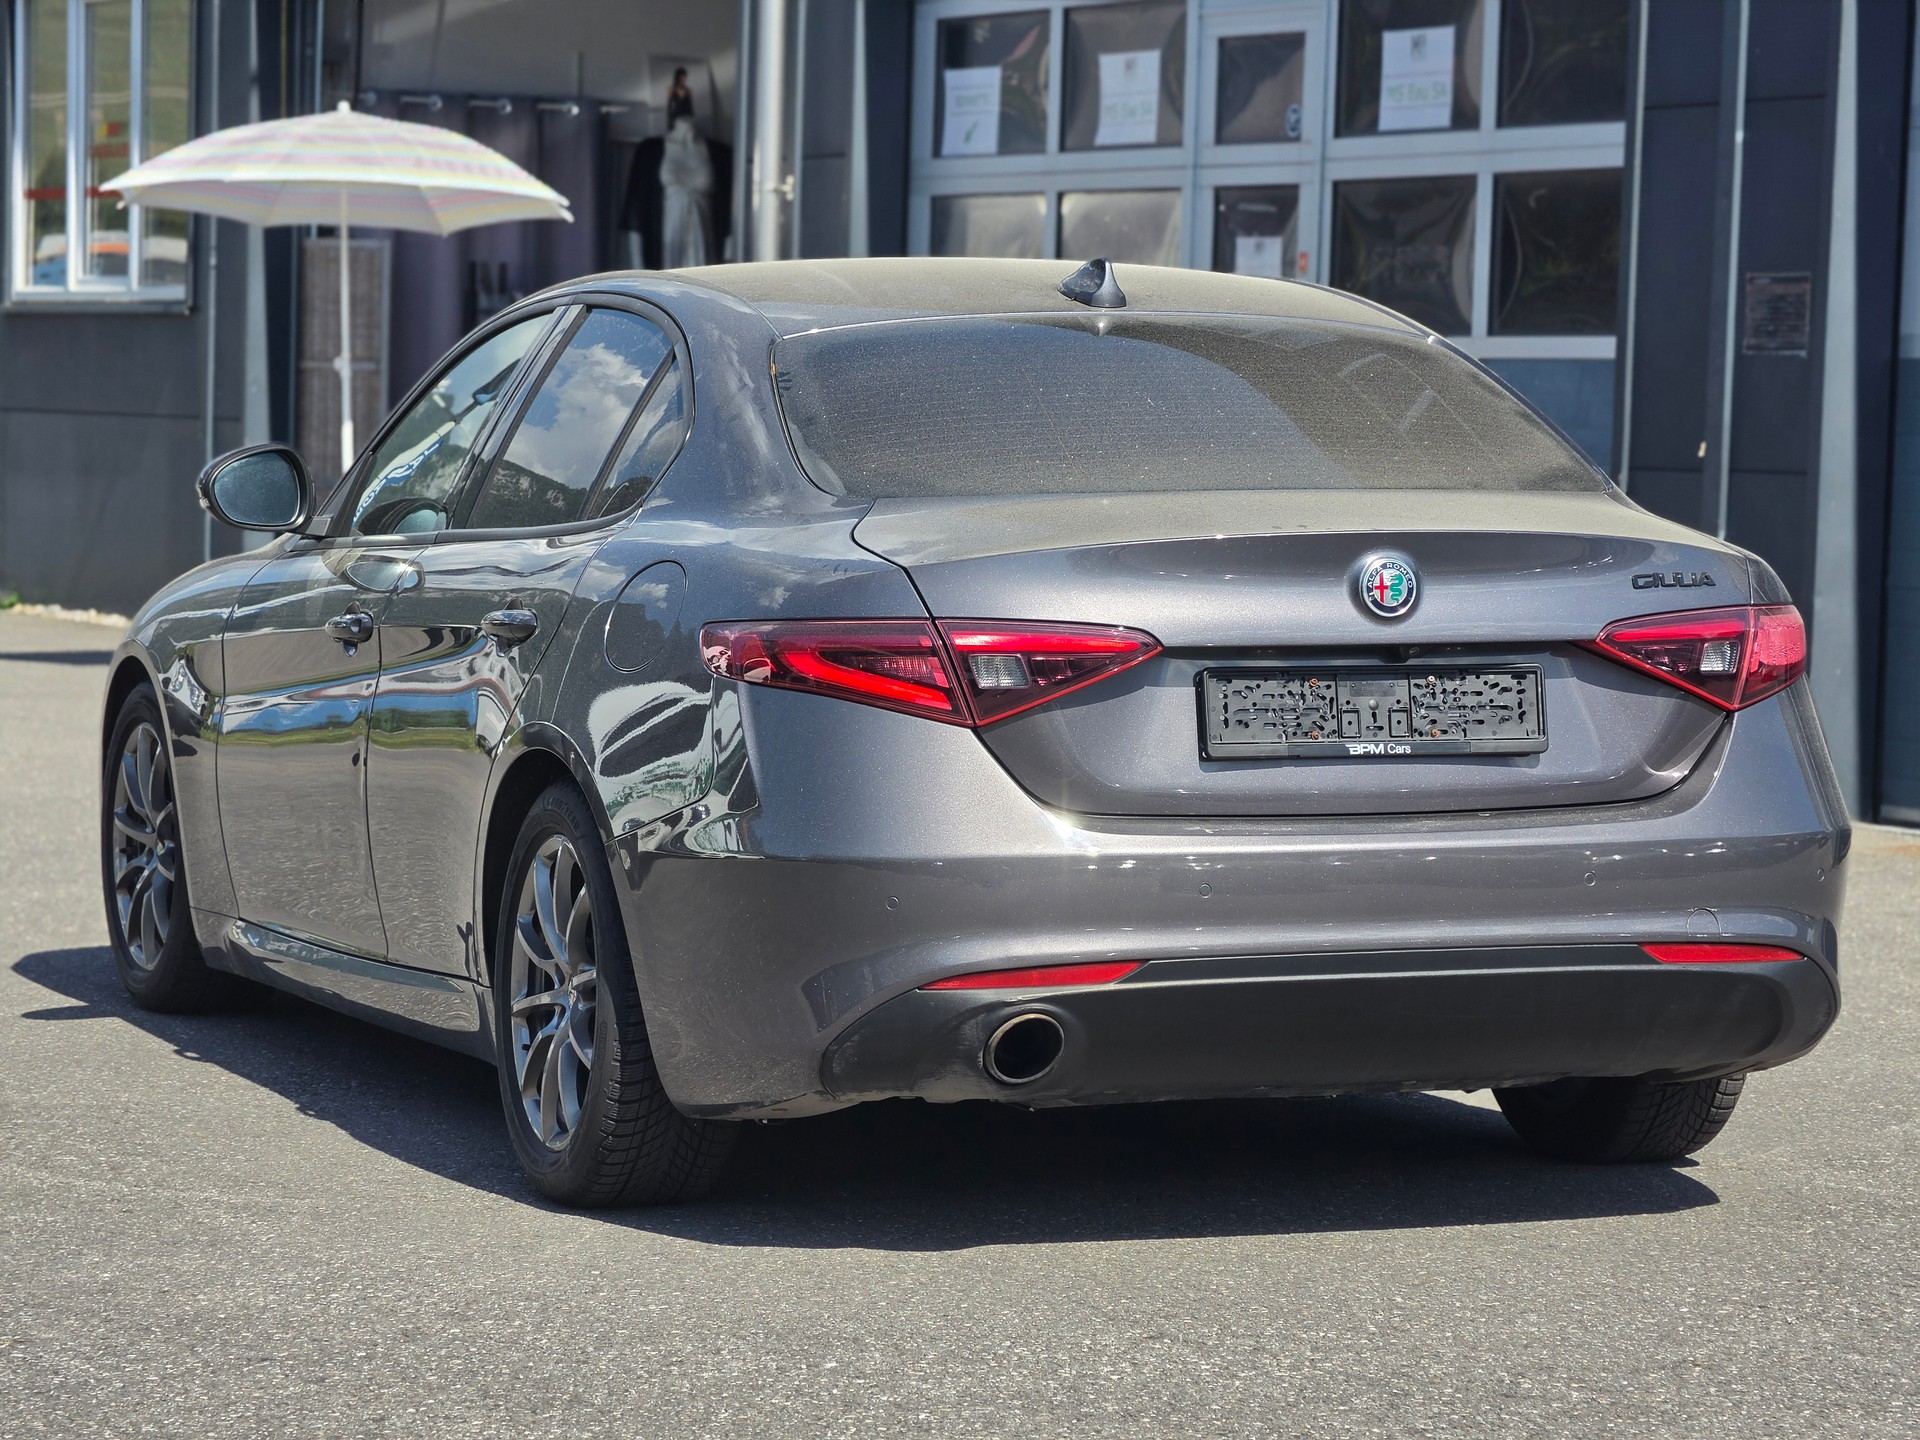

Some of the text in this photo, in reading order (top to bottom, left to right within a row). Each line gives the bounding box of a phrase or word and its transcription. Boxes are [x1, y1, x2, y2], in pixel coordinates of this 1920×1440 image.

[1367, 562, 1413, 589] ALFA ROMEO
[1631, 571, 1717, 590] GIULIA
[1345, 743, 1411, 755] BPM Cars
